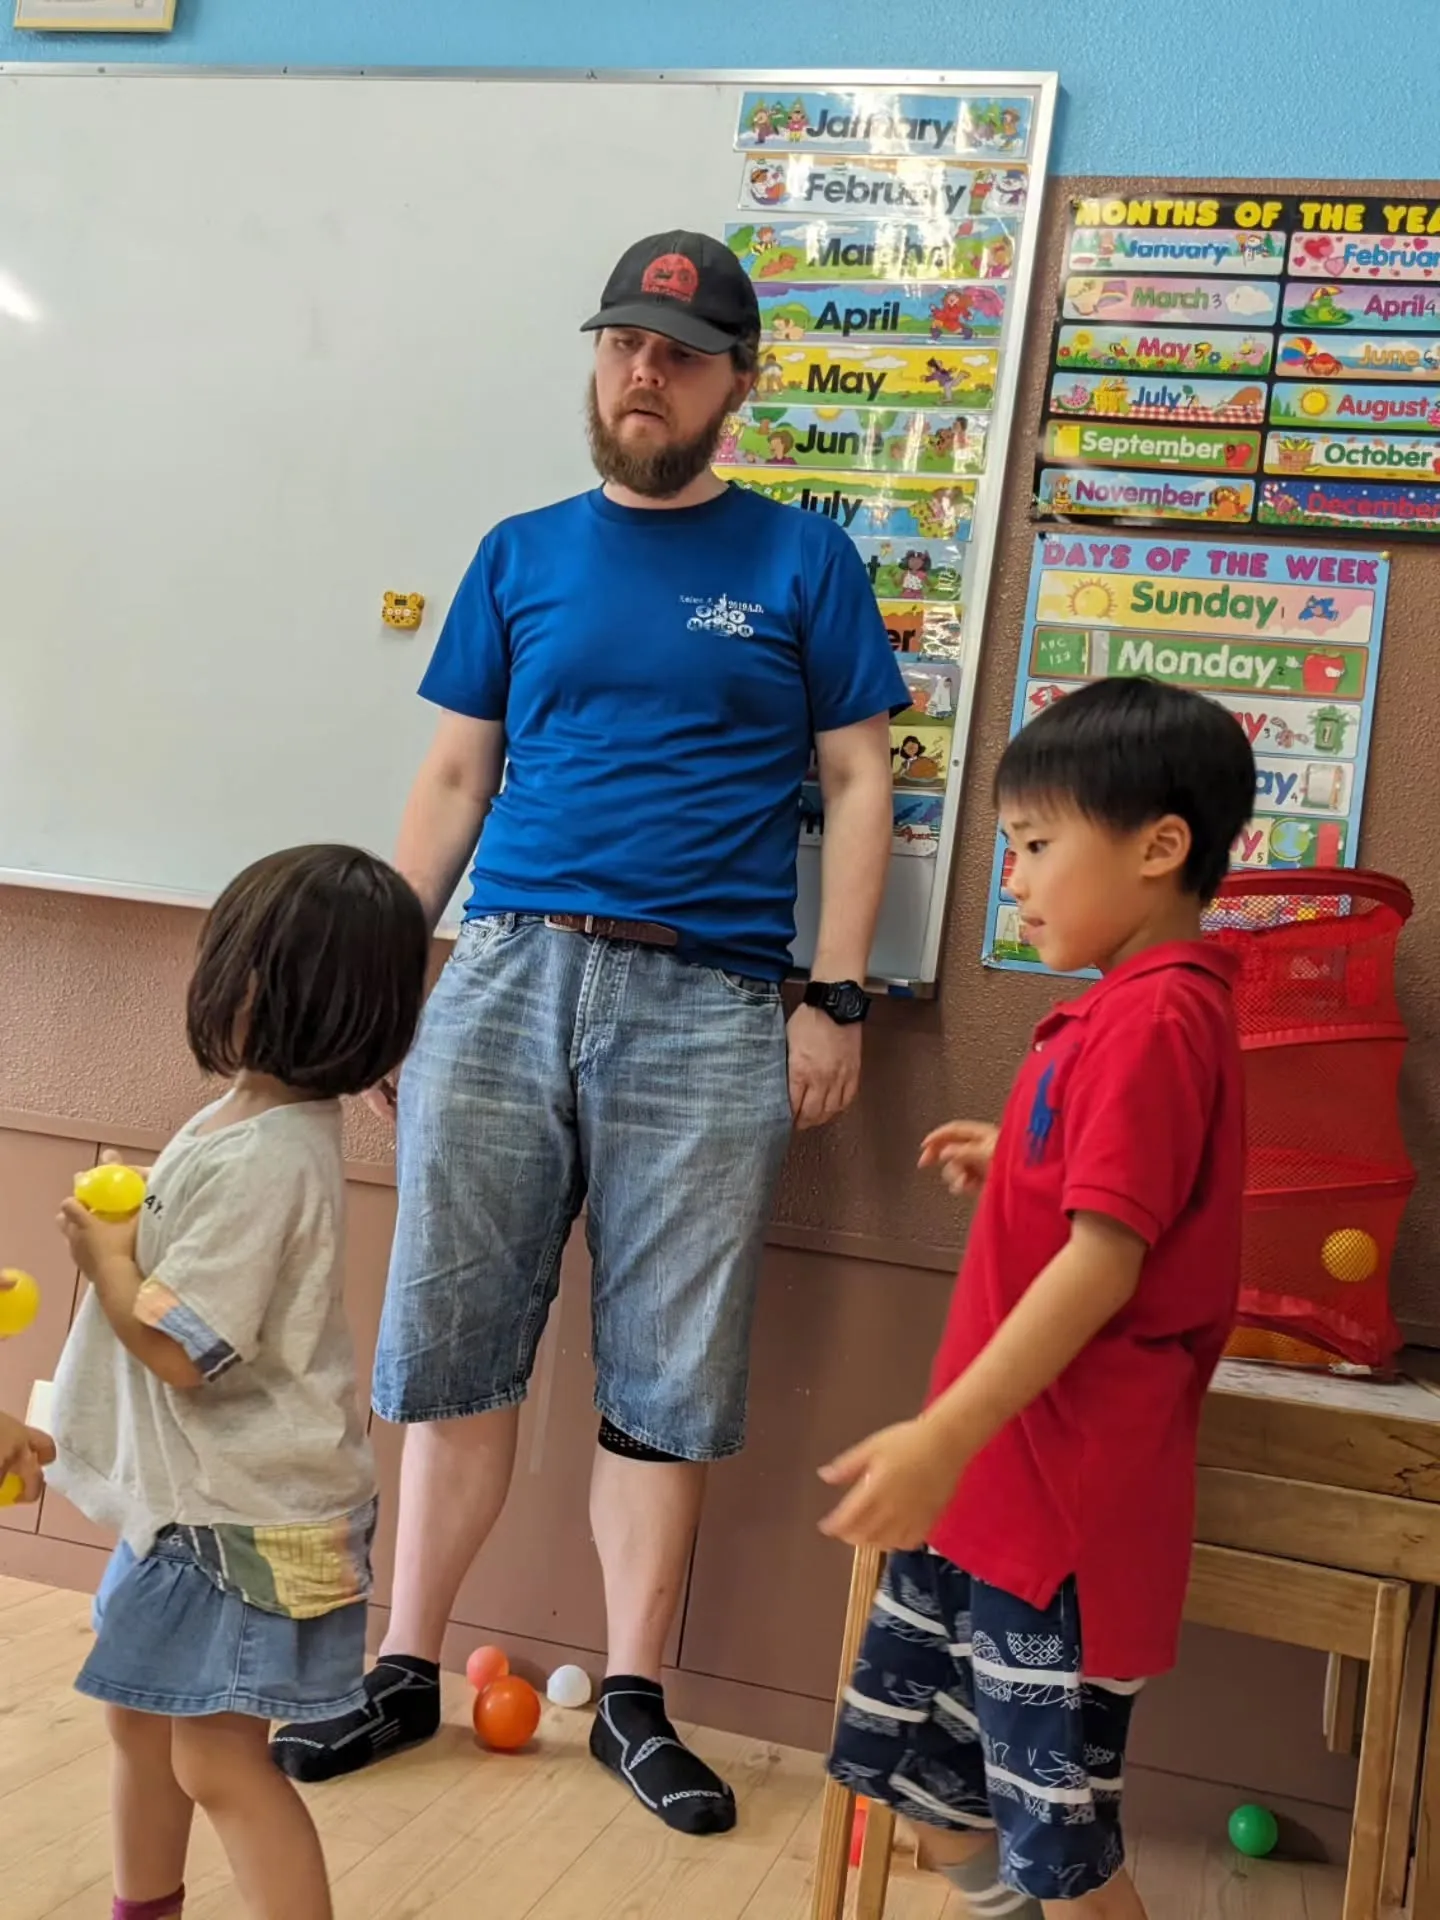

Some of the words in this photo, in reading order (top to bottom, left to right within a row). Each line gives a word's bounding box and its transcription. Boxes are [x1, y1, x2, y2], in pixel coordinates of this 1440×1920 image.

[805, 173, 966, 215] Februy
[1075, 199, 1219, 227] MONTHS
[1234, 201, 1283, 228] OF
[1300, 203, 1366, 232] THE
[1383, 205, 1440, 234] YEA
[807, 238, 924, 267] Marh
[1122, 239, 1231, 266] January
[1344, 243, 1440, 268] Februar
[1130, 286, 1210, 310] March
[1212, 294, 1223, 309] 3
[1364, 294, 1426, 321] April
[814, 301, 900, 336] April
[1136, 336, 1192, 362] May
[1359, 345, 1420, 367] June
[807, 364, 887, 401] May
[1132, 385, 1182, 411] July
[1336, 395, 1430, 421] August
[795, 424, 884, 456] June
[1081, 431, 1224, 459] September
[1324, 443, 1433, 468] October
[1076, 480, 1206, 508] November
[1042, 543, 1131, 569] DAYS
[1146, 547, 1191, 572] OF
[1207, 550, 1270, 578] THE
[1286, 554, 1379, 585] WEEK
[1130, 581, 1279, 629] Sunday
[1117, 640, 1277, 688] Monday
